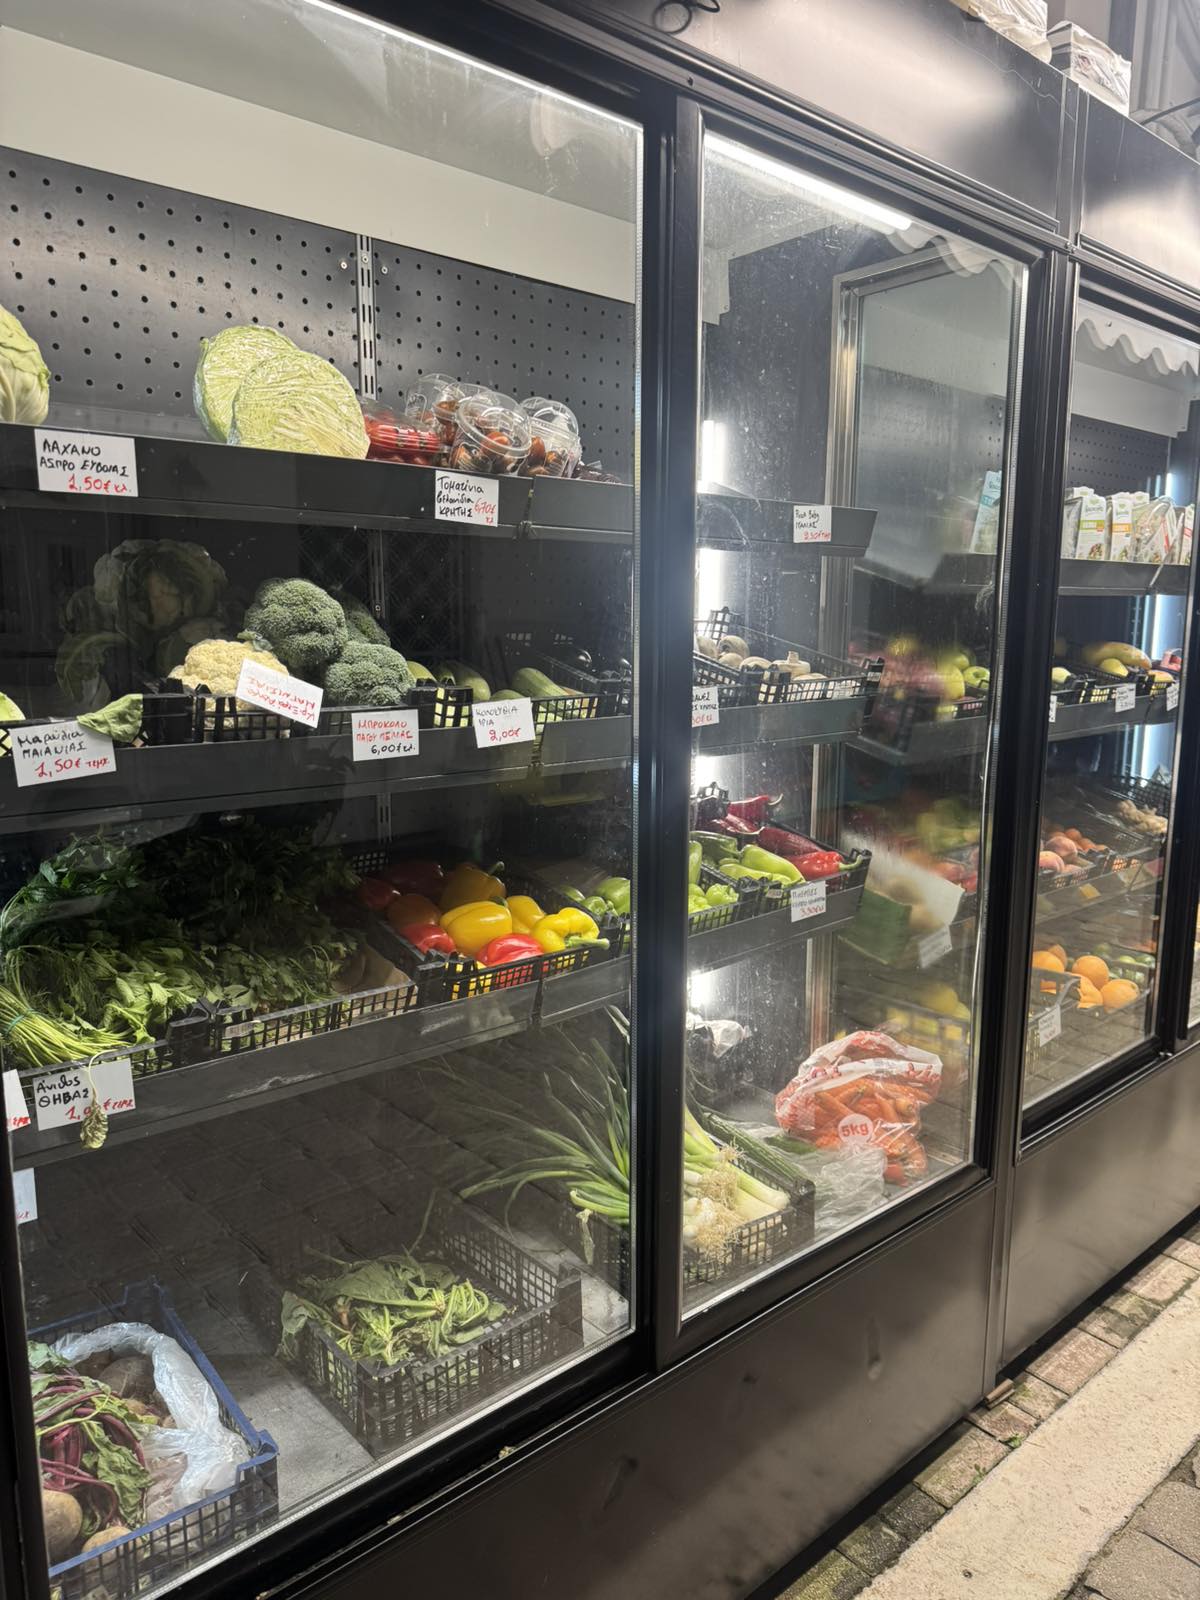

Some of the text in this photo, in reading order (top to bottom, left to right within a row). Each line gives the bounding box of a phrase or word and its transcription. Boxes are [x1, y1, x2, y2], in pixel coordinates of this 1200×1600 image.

[43, 438, 101, 456] ΛΑΧΑΝΟ
[40, 456, 129, 477] ΑΣΠΡΟ ΕΥΒΟΙΑΣ
[68, 473, 111, 493] 1,50€
[439, 506, 473, 517] ΚΡΗΤΗΣ
[22, 741, 88, 759] ΠΑΙΑΝΙΑΣ
[35, 758, 81, 778] 1,50€
[39, 1087, 90, 1108] ΘΗΒΑΣ
[841, 1122, 869, 1138] 5kg
